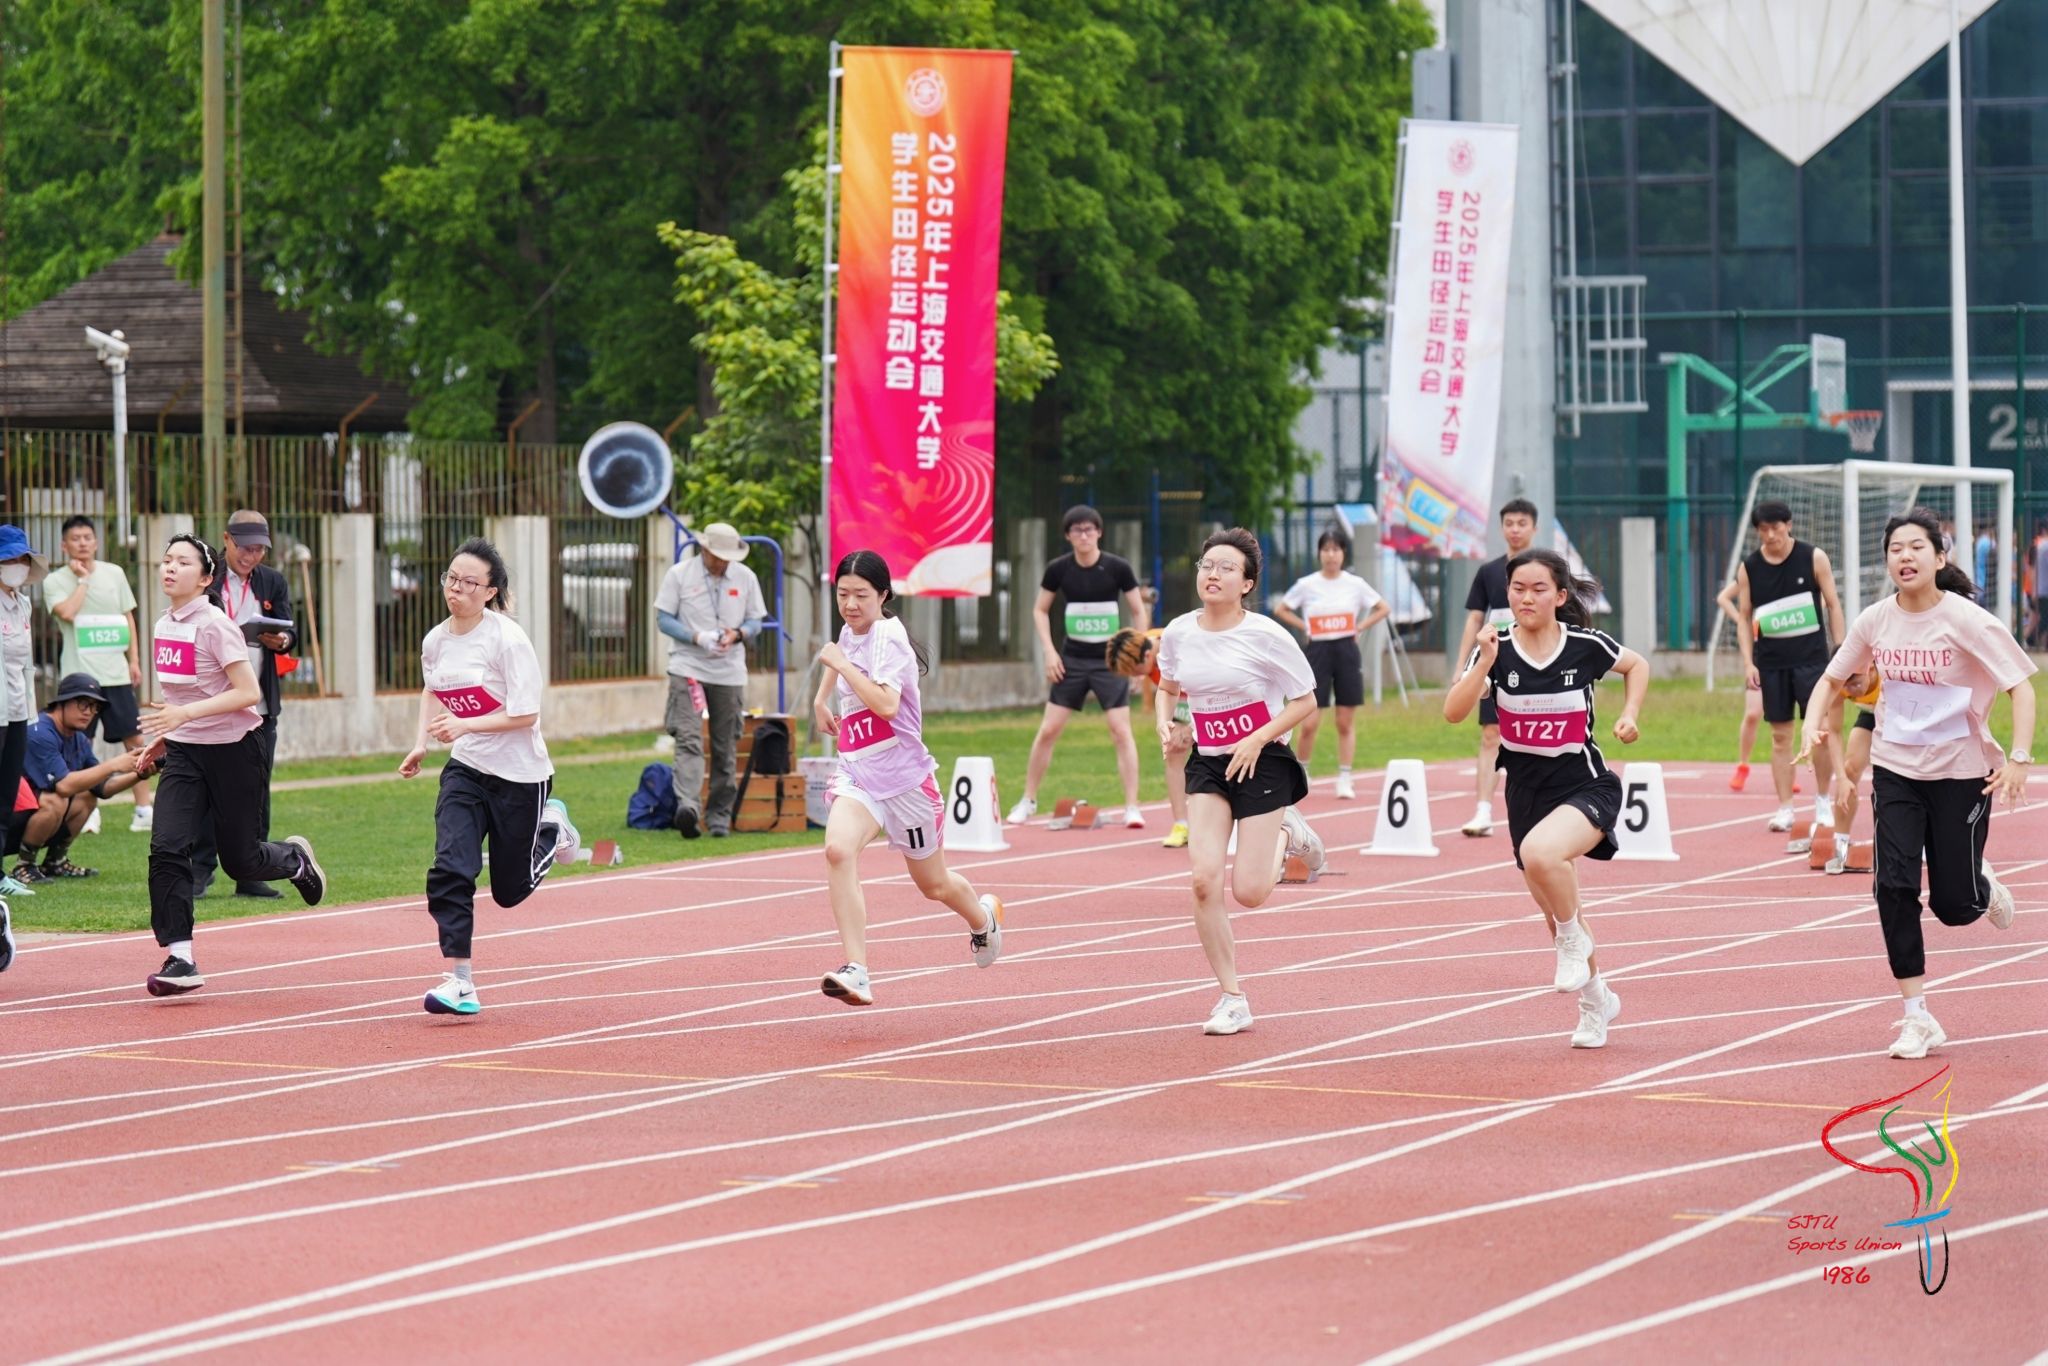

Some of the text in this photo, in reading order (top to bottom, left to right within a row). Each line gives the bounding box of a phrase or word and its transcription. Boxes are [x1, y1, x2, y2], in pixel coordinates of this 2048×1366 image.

[885, 131, 919, 390] 学生田径运动会
[917, 131, 957, 470] 2025年上海交通大学
[1420, 190, 1454, 394] 学生田径运动会
[1440, 191, 1481, 456] 2025年上海交通大学
[1075, 618, 1109, 632] 0535
[1770, 611, 1805, 630] 0443
[87, 629, 120, 643] 1525
[156, 646, 182, 667] 2504
[1873, 648, 1952, 667] POSITIVE
[443, 694, 482, 712] 2615
[1204, 714, 1254, 739] 0310
[1511, 720, 1568, 740] 1727
[953, 776, 972, 824] 8
[1387, 779, 1410, 828] 6
[1625, 783, 1650, 832] 5
[906, 826, 925, 849] 11
